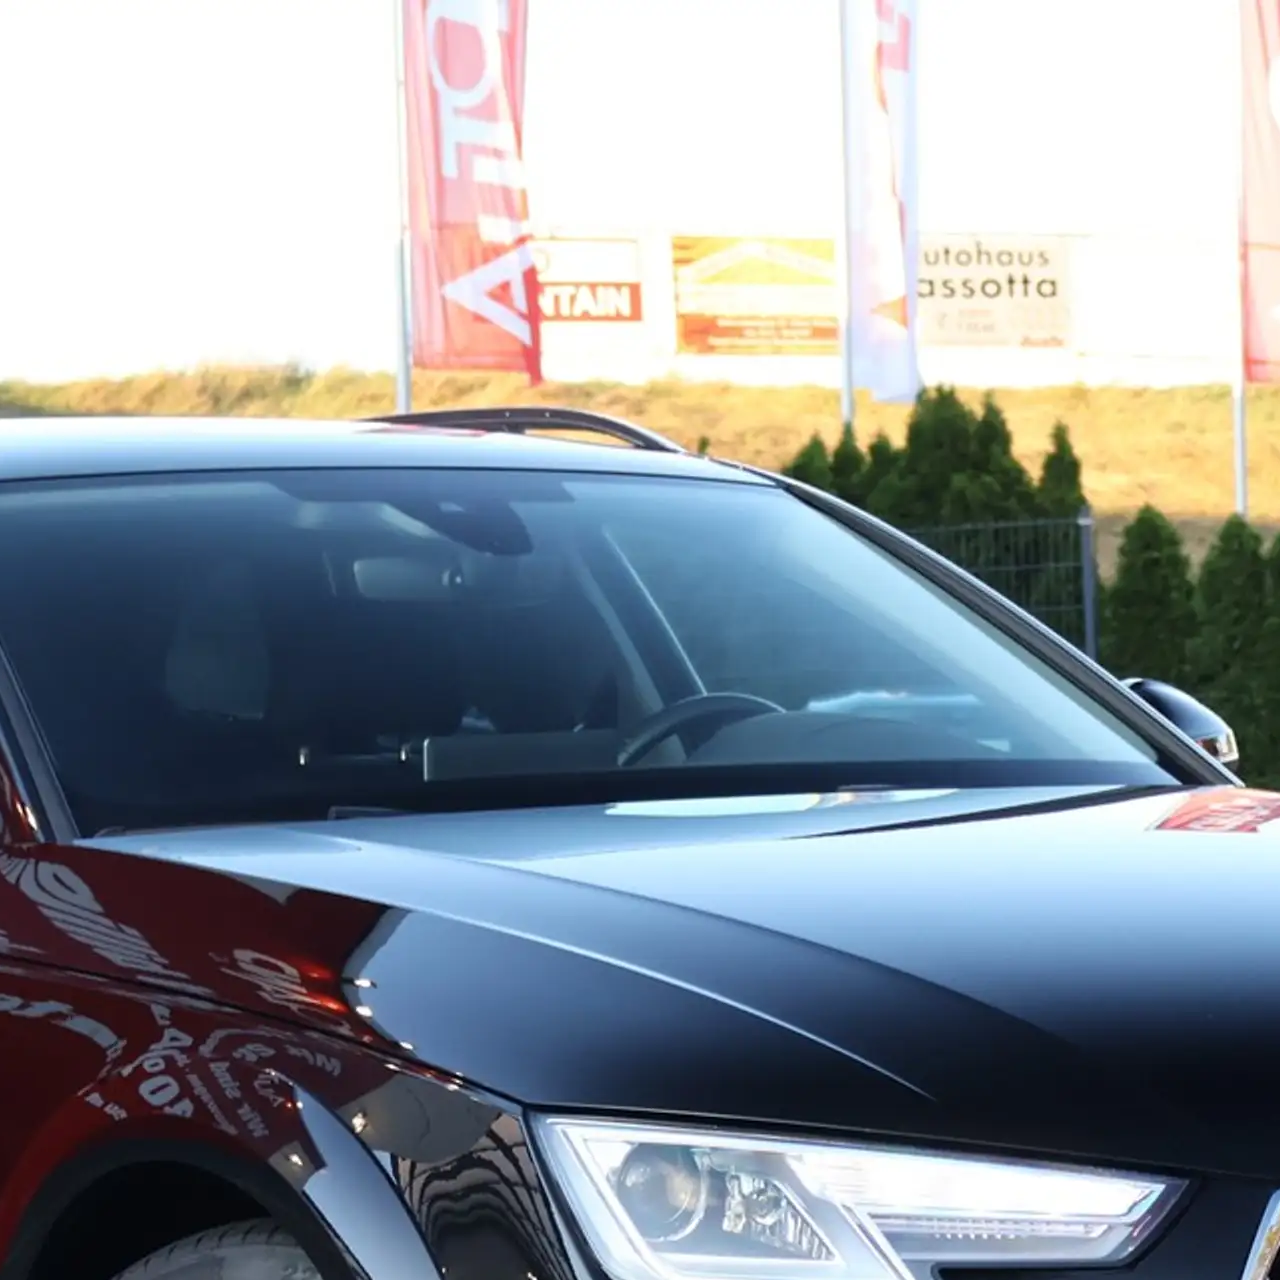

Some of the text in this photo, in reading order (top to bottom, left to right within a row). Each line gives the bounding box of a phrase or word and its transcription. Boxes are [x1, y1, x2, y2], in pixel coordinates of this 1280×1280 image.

[923, 240, 1051, 267] utohaus
[917, 273, 1058, 299] assotta
[538, 285, 631, 318] NTAIN
